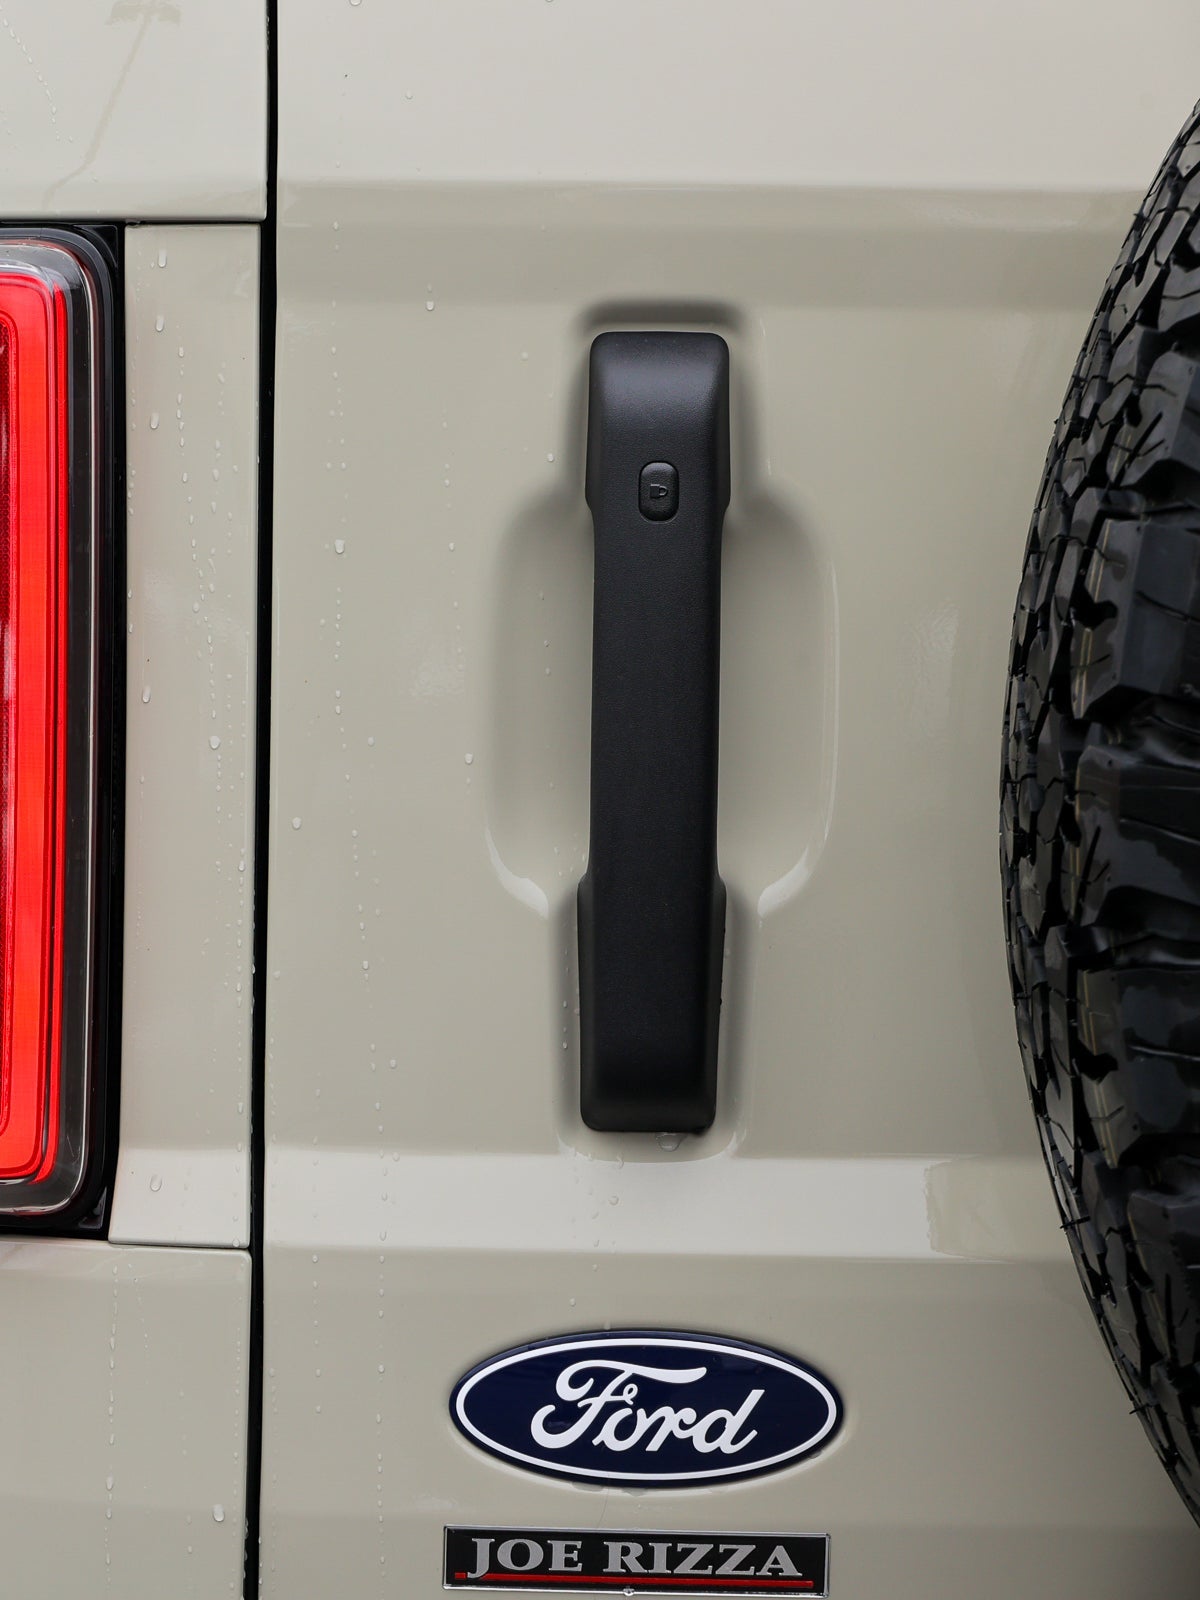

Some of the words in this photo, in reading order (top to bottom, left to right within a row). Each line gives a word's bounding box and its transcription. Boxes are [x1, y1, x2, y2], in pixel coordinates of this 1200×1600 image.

[531, 1359, 765, 1454] Ford
[467, 1537, 583, 1579] JOE
[603, 1541, 803, 1576] RIZZA
